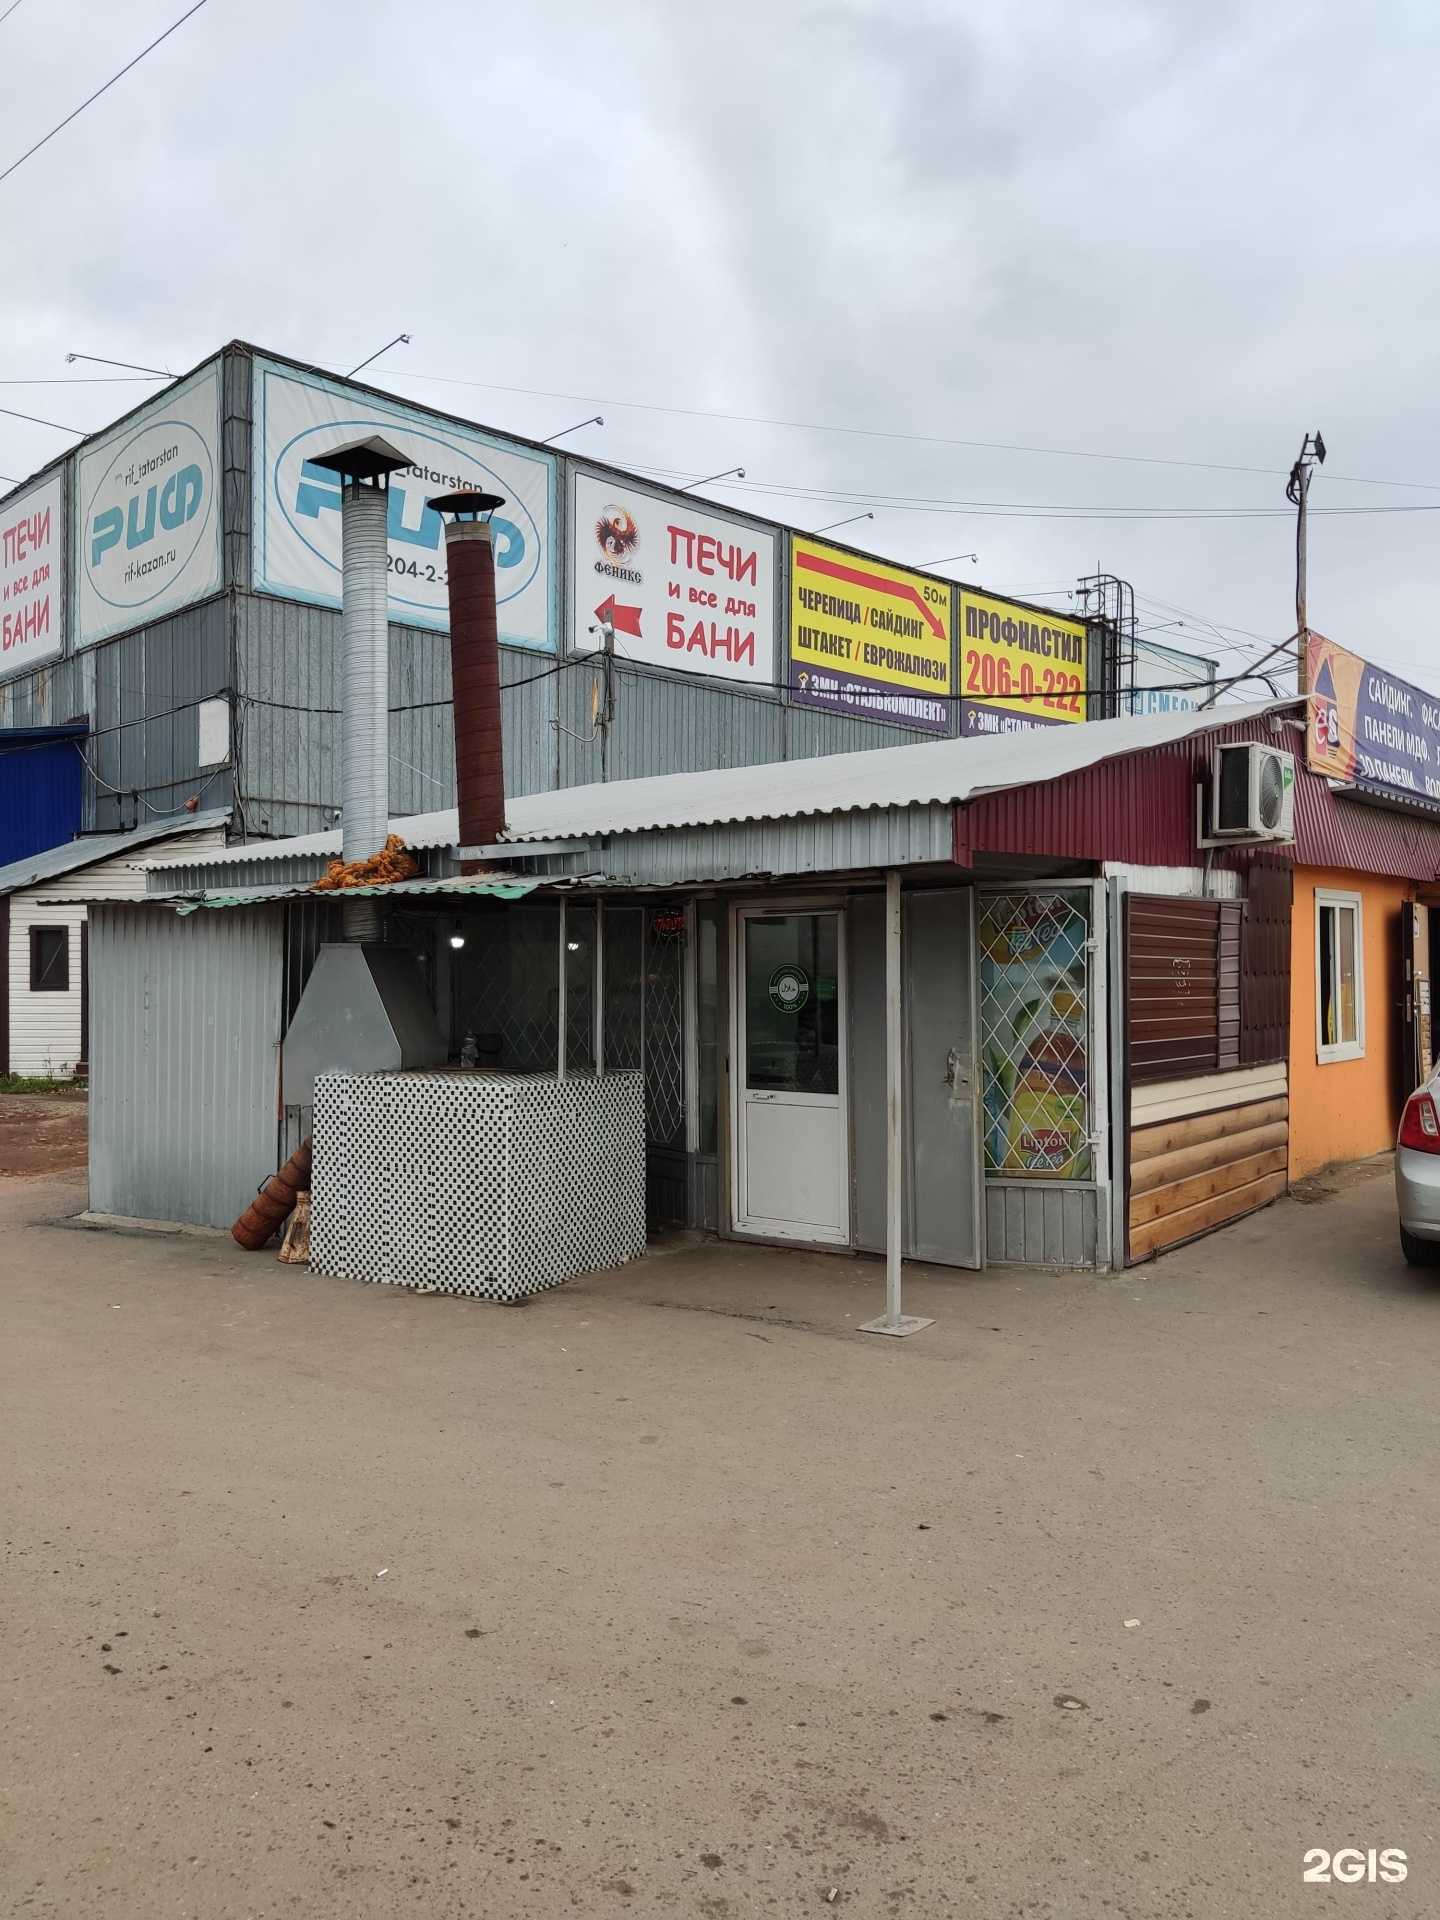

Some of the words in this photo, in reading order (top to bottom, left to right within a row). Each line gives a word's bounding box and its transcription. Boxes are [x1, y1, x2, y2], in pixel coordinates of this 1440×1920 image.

[124, 445, 178, 486] rif_tatarstan
[3, 506, 50, 568] ПЕЧИ
[91, 463, 203, 568] РИФ
[3, 585, 9, 600] и
[14, 576, 28, 597] все
[32, 563, 50, 590] для
[124, 548, 176, 584] rif-kazan.ru
[667, 525, 757, 587] ПЕЧИ
[3, 594, 50, 651] БАНИ
[668, 581, 680, 599] и
[689, 588, 718, 608] все
[725, 597, 756, 618] для
[798, 586, 861, 625] ЧЕРЕПИЦА
[870, 608, 924, 640] САЙДИНГ
[666, 612, 755, 667] БАНИ
[798, 625, 852, 659] ШТАКЕТ
[863, 642, 947, 682] ЕВРОЖАЛЮЗИ
[965, 605, 1082, 664] ПРОФНАСТИЛ
[966, 650, 1081, 713] 206-0-222
[1368, 677, 1413, 718] САЙДИНГ.
[978, 711, 999, 733] ЗМК
[1364, 716, 1405, 752] ПАНЕЛИ
[1406, 730, 1430, 762] МДФ.
